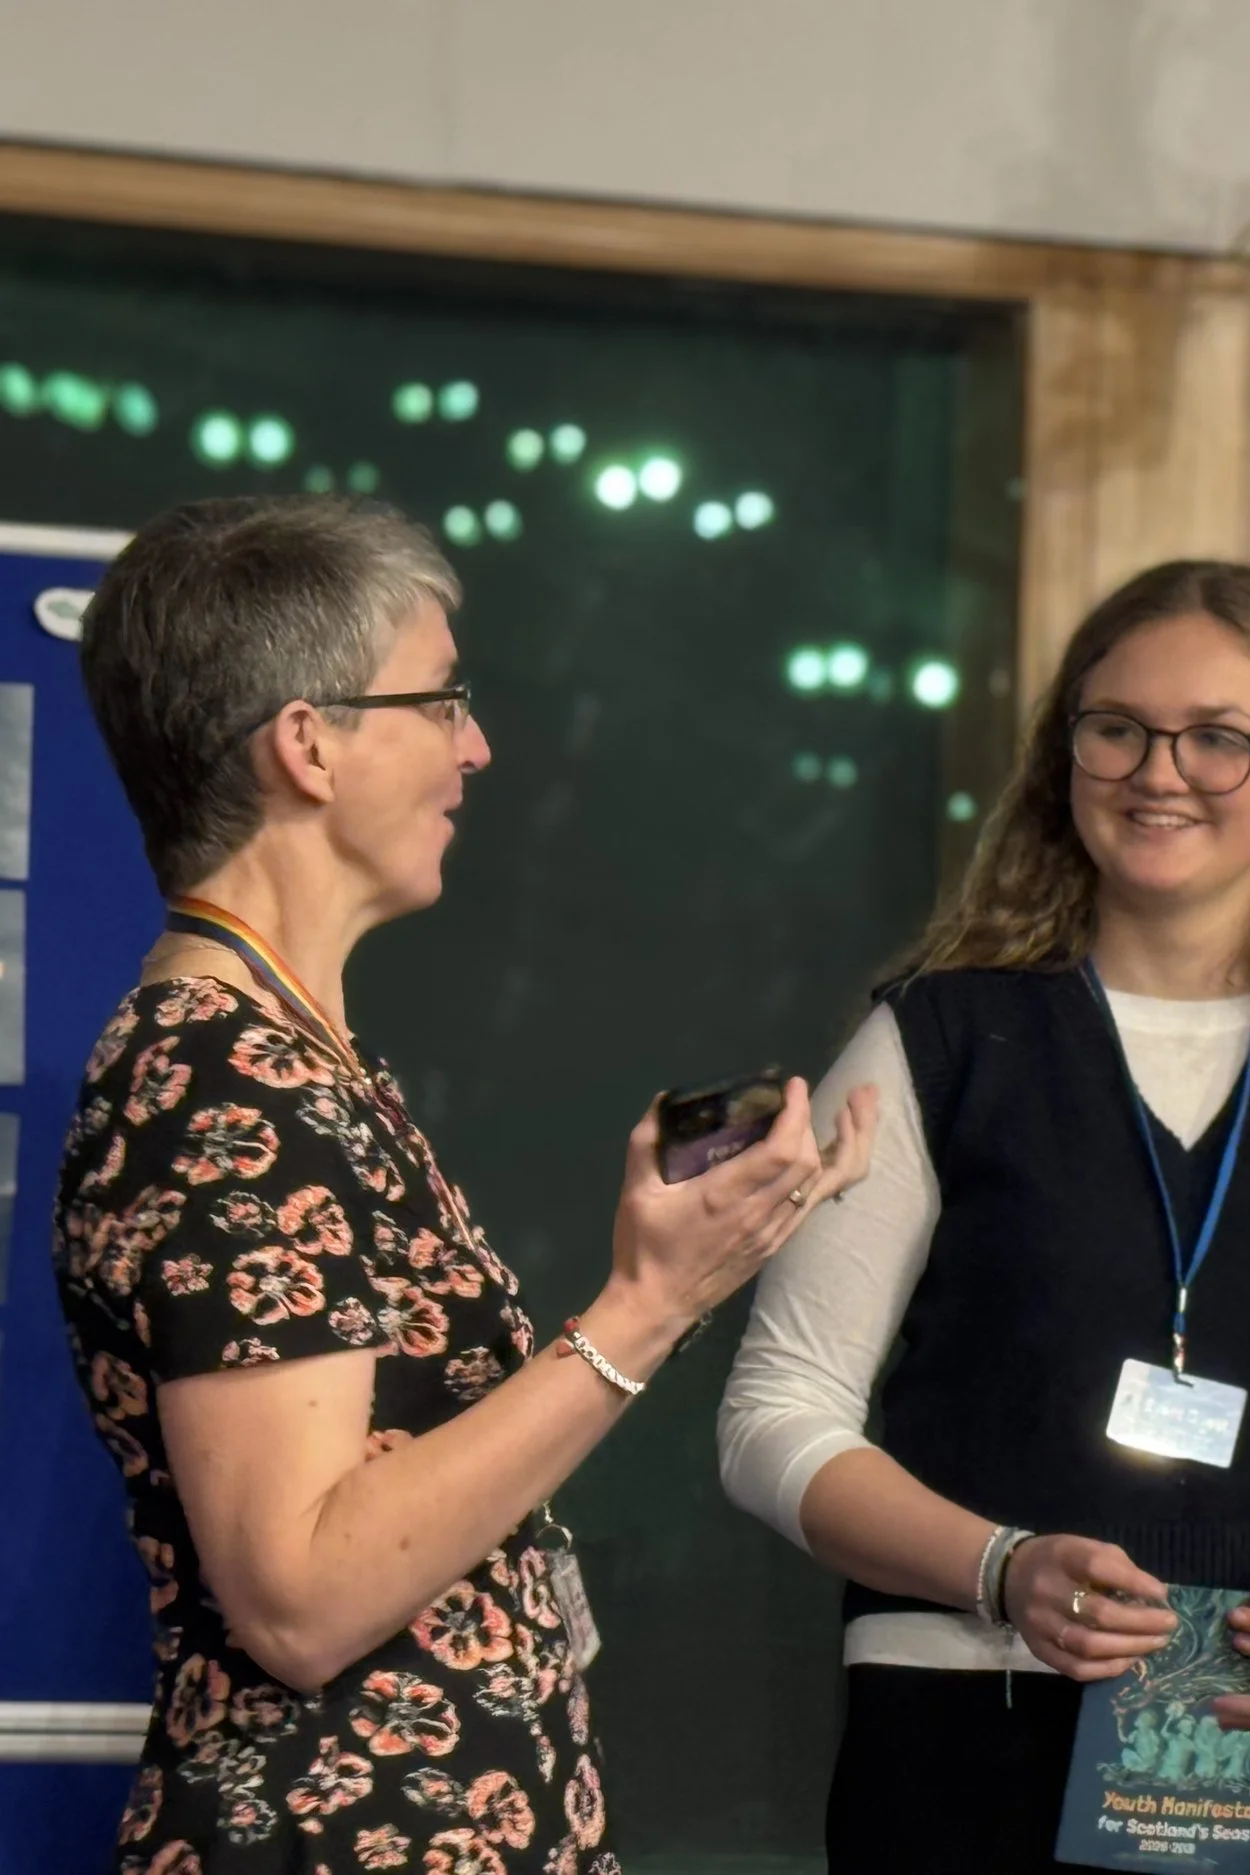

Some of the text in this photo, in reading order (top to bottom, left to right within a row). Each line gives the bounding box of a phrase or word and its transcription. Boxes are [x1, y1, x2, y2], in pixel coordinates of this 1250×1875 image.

[1102, 1791, 1157, 1814] Youth
[1098, 1815, 1250, 1842] for Scotland's Seas
